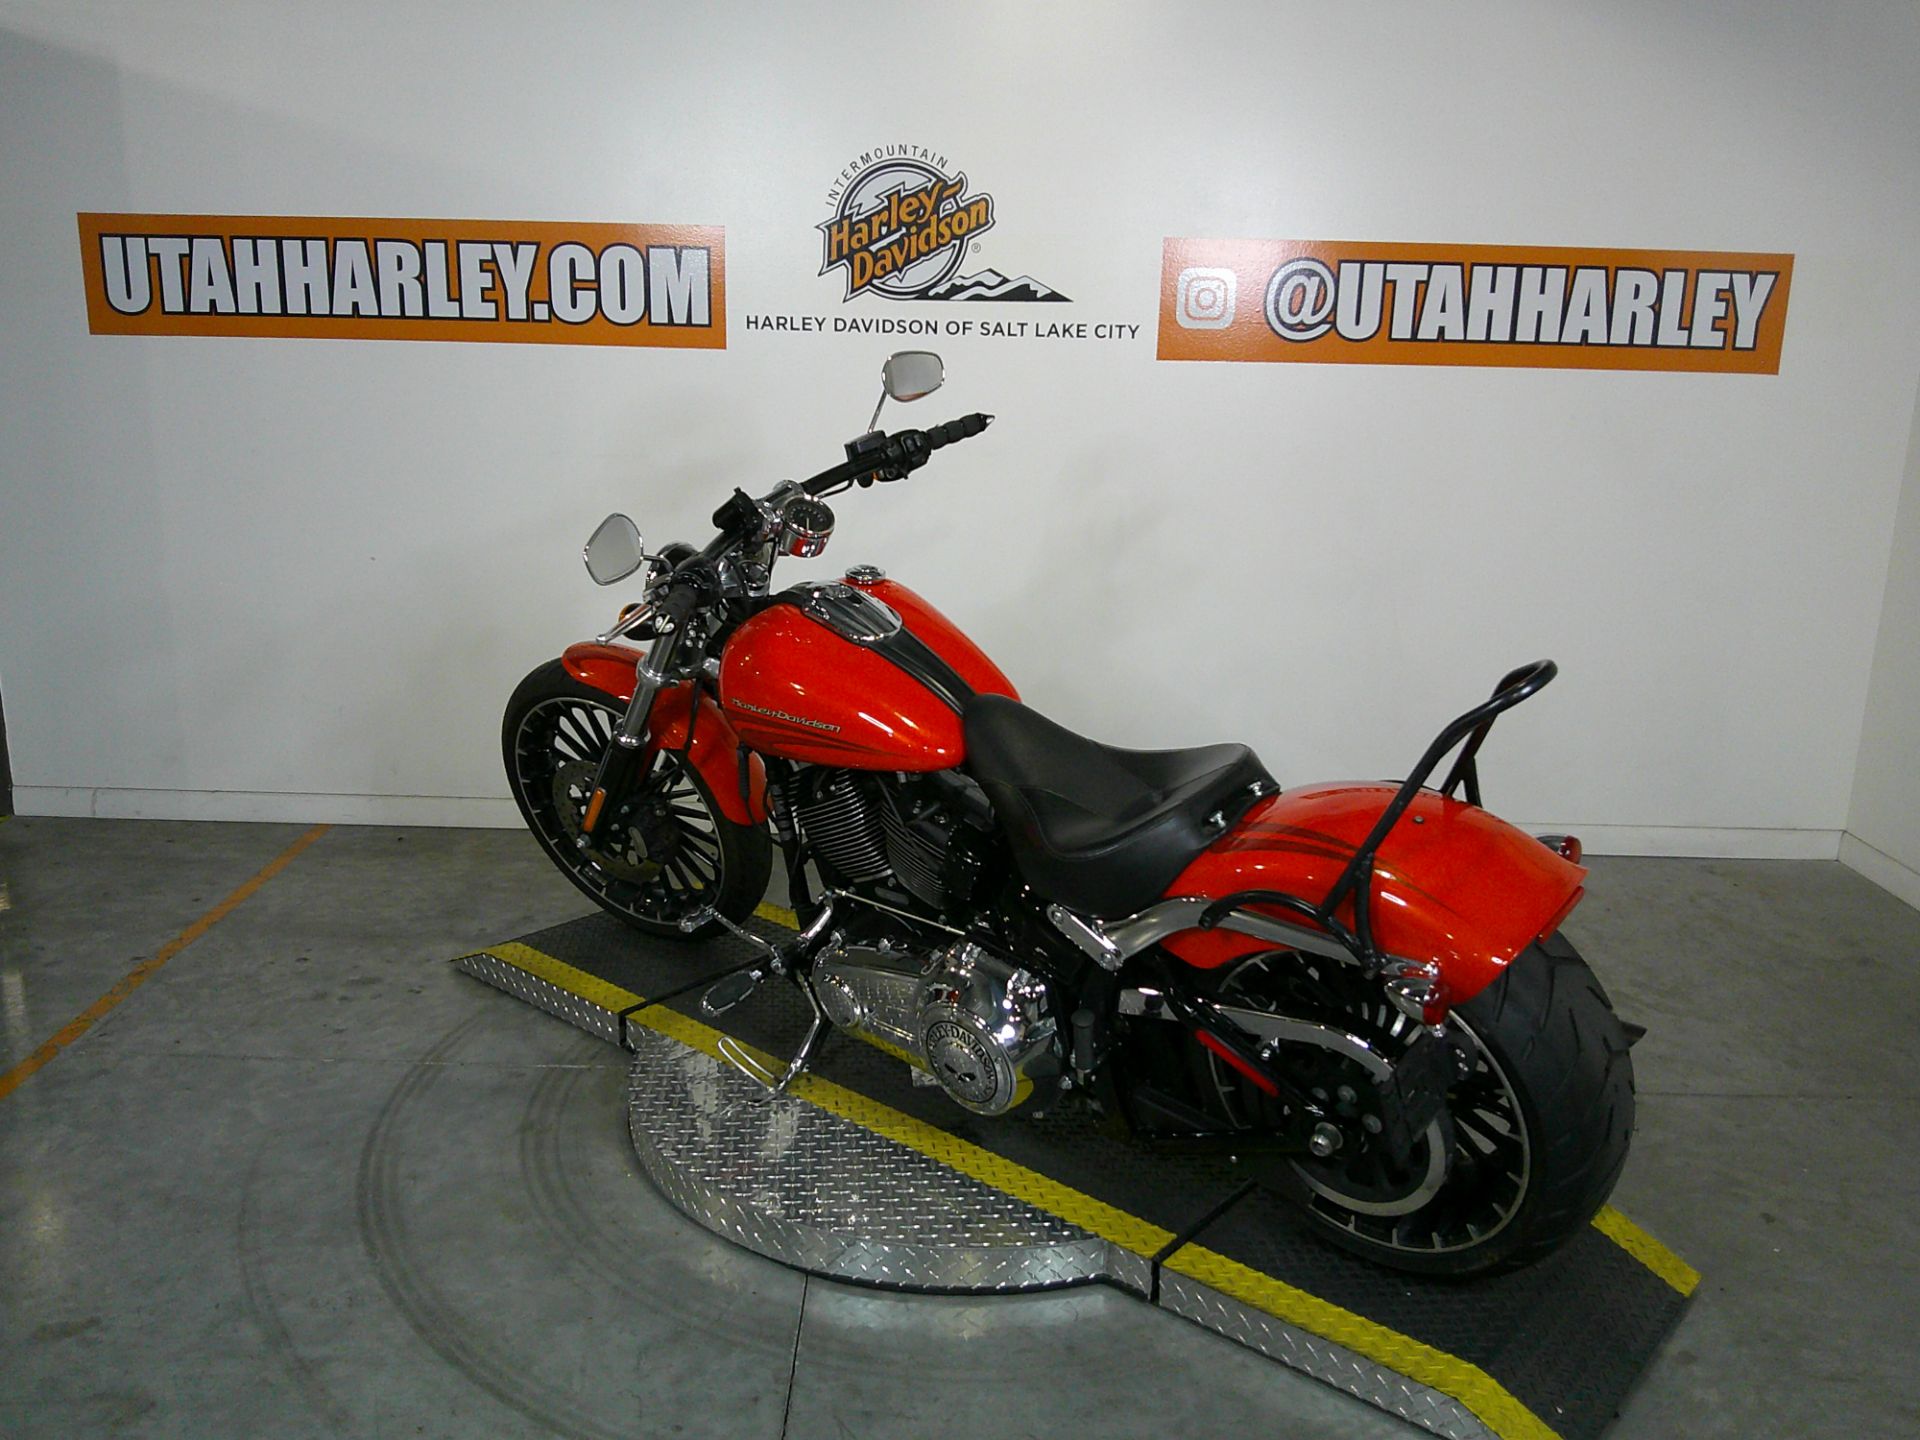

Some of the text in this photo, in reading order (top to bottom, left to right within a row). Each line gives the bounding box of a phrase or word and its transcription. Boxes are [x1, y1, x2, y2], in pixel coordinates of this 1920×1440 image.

[825, 143, 949, 207] INTERMOUNTAIN
[829, 178, 963, 262] Harley-
[852, 199, 989, 291] Davidson
[100, 233, 712, 328] UTAHHARLEY.COM
[1264, 256, 1780, 351] @UTAHHARLEY
[746, 315, 1140, 340] HARLEY DAVIDSON OF SALT LAKE CITY
